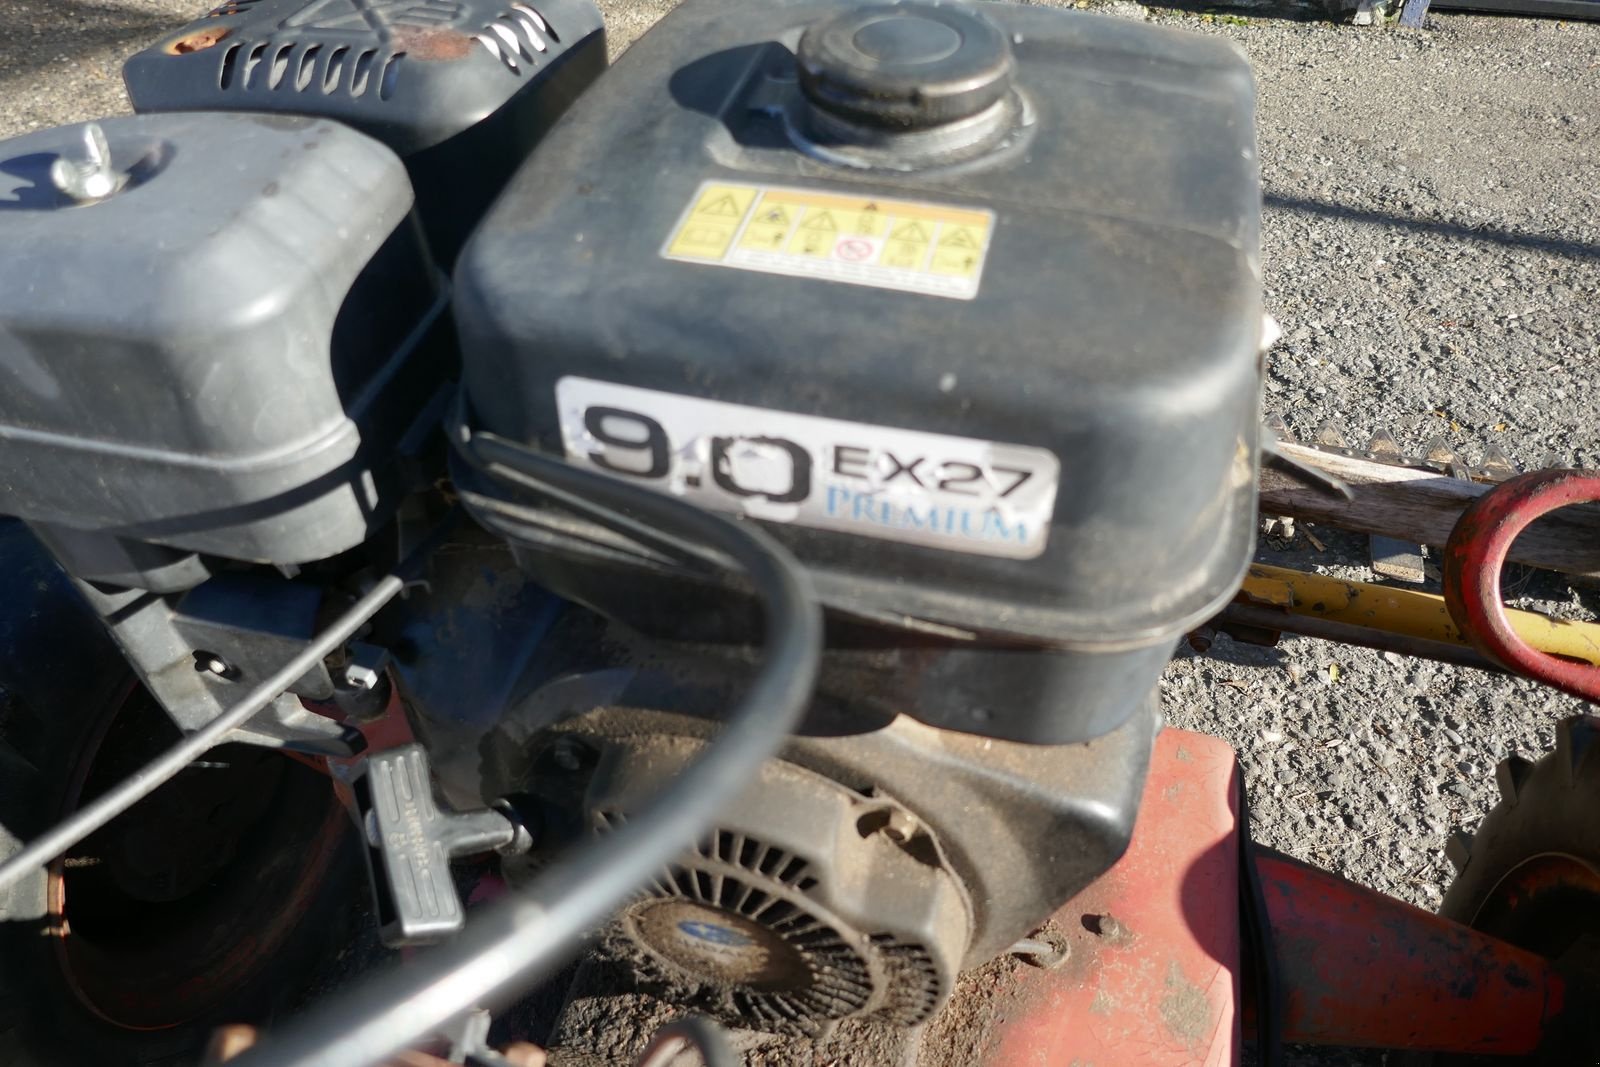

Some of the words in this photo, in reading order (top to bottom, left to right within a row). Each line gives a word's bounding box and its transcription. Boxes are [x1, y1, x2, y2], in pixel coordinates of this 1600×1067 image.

[584, 405, 813, 504] 9.0
[833, 445, 1033, 498] EX27
[825, 486, 1028, 542] PREMIUM
